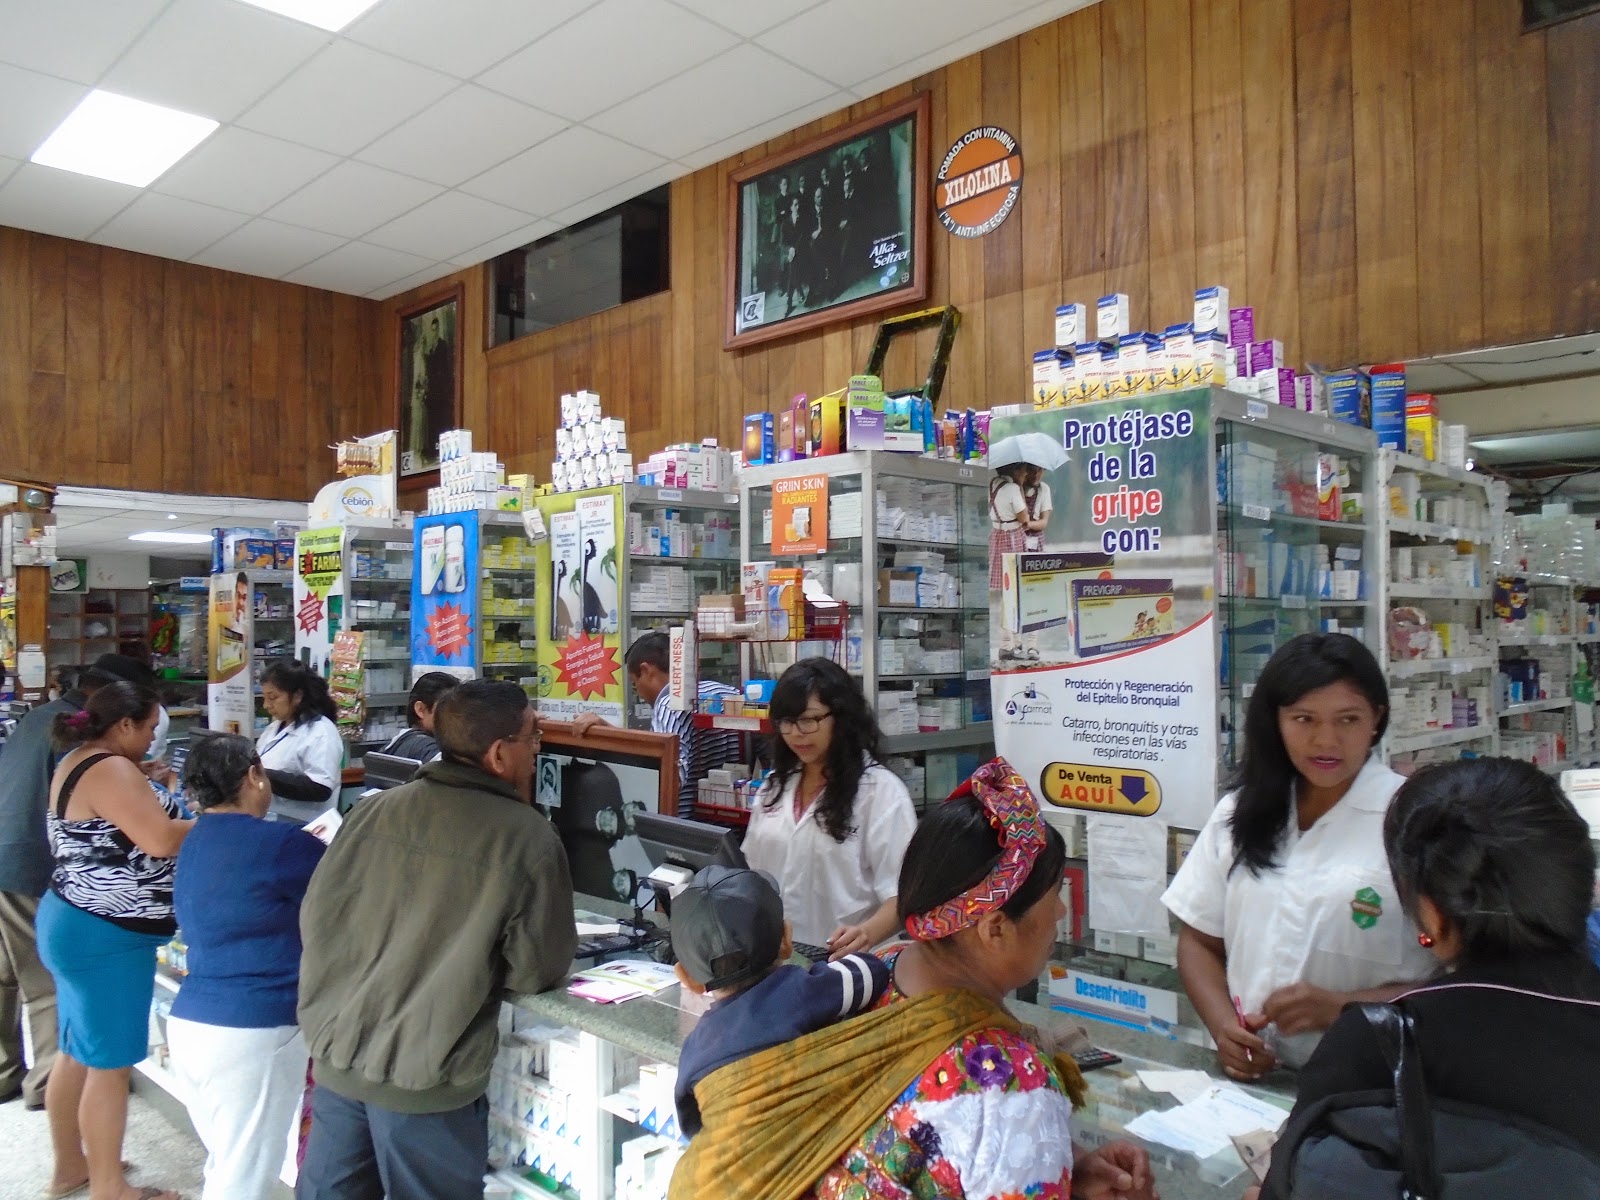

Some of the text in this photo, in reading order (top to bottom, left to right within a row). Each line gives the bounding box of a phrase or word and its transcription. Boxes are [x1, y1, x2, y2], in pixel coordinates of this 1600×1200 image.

[938, 127, 1016, 180] POMADA CON VITAMINA
[944, 160, 1012, 206] XILOLINA
[869, 242, 897, 259] Alka-
[873, 249, 911, 269] Seltzer
[1064, 410, 1193, 449] Protéjase
[1090, 448, 1156, 482] de la
[803, 477, 825, 491] SKIN
[341, 495, 374, 507] Cebión
[582, 500, 607, 510] ESTIMAX
[1092, 486, 1162, 524] gripe
[1103, 527, 1160, 554] con:
[1025, 558, 1063, 571] PREVIGRIP
[1083, 584, 1123, 596] PREVIGRIP
[672, 635, 684, 698] ALERT-NESS
[1064, 678, 1193, 695] Protección y Regeneración
[1076, 692, 1180, 709] del Epitelio Bronquial
[1062, 717, 1101, 731] Catarro,
[1104, 718, 1158, 735] bronquitis
[1161, 723, 1168, 736] y
[1170, 722, 1199, 736] otras
[1073, 732, 1187, 750] infecciones en las vías
[1059, 769, 1112, 784] De Venta
[1060, 784, 1114, 805] AQUÍ
[1076, 977, 1146, 1010] Desenfriolito
